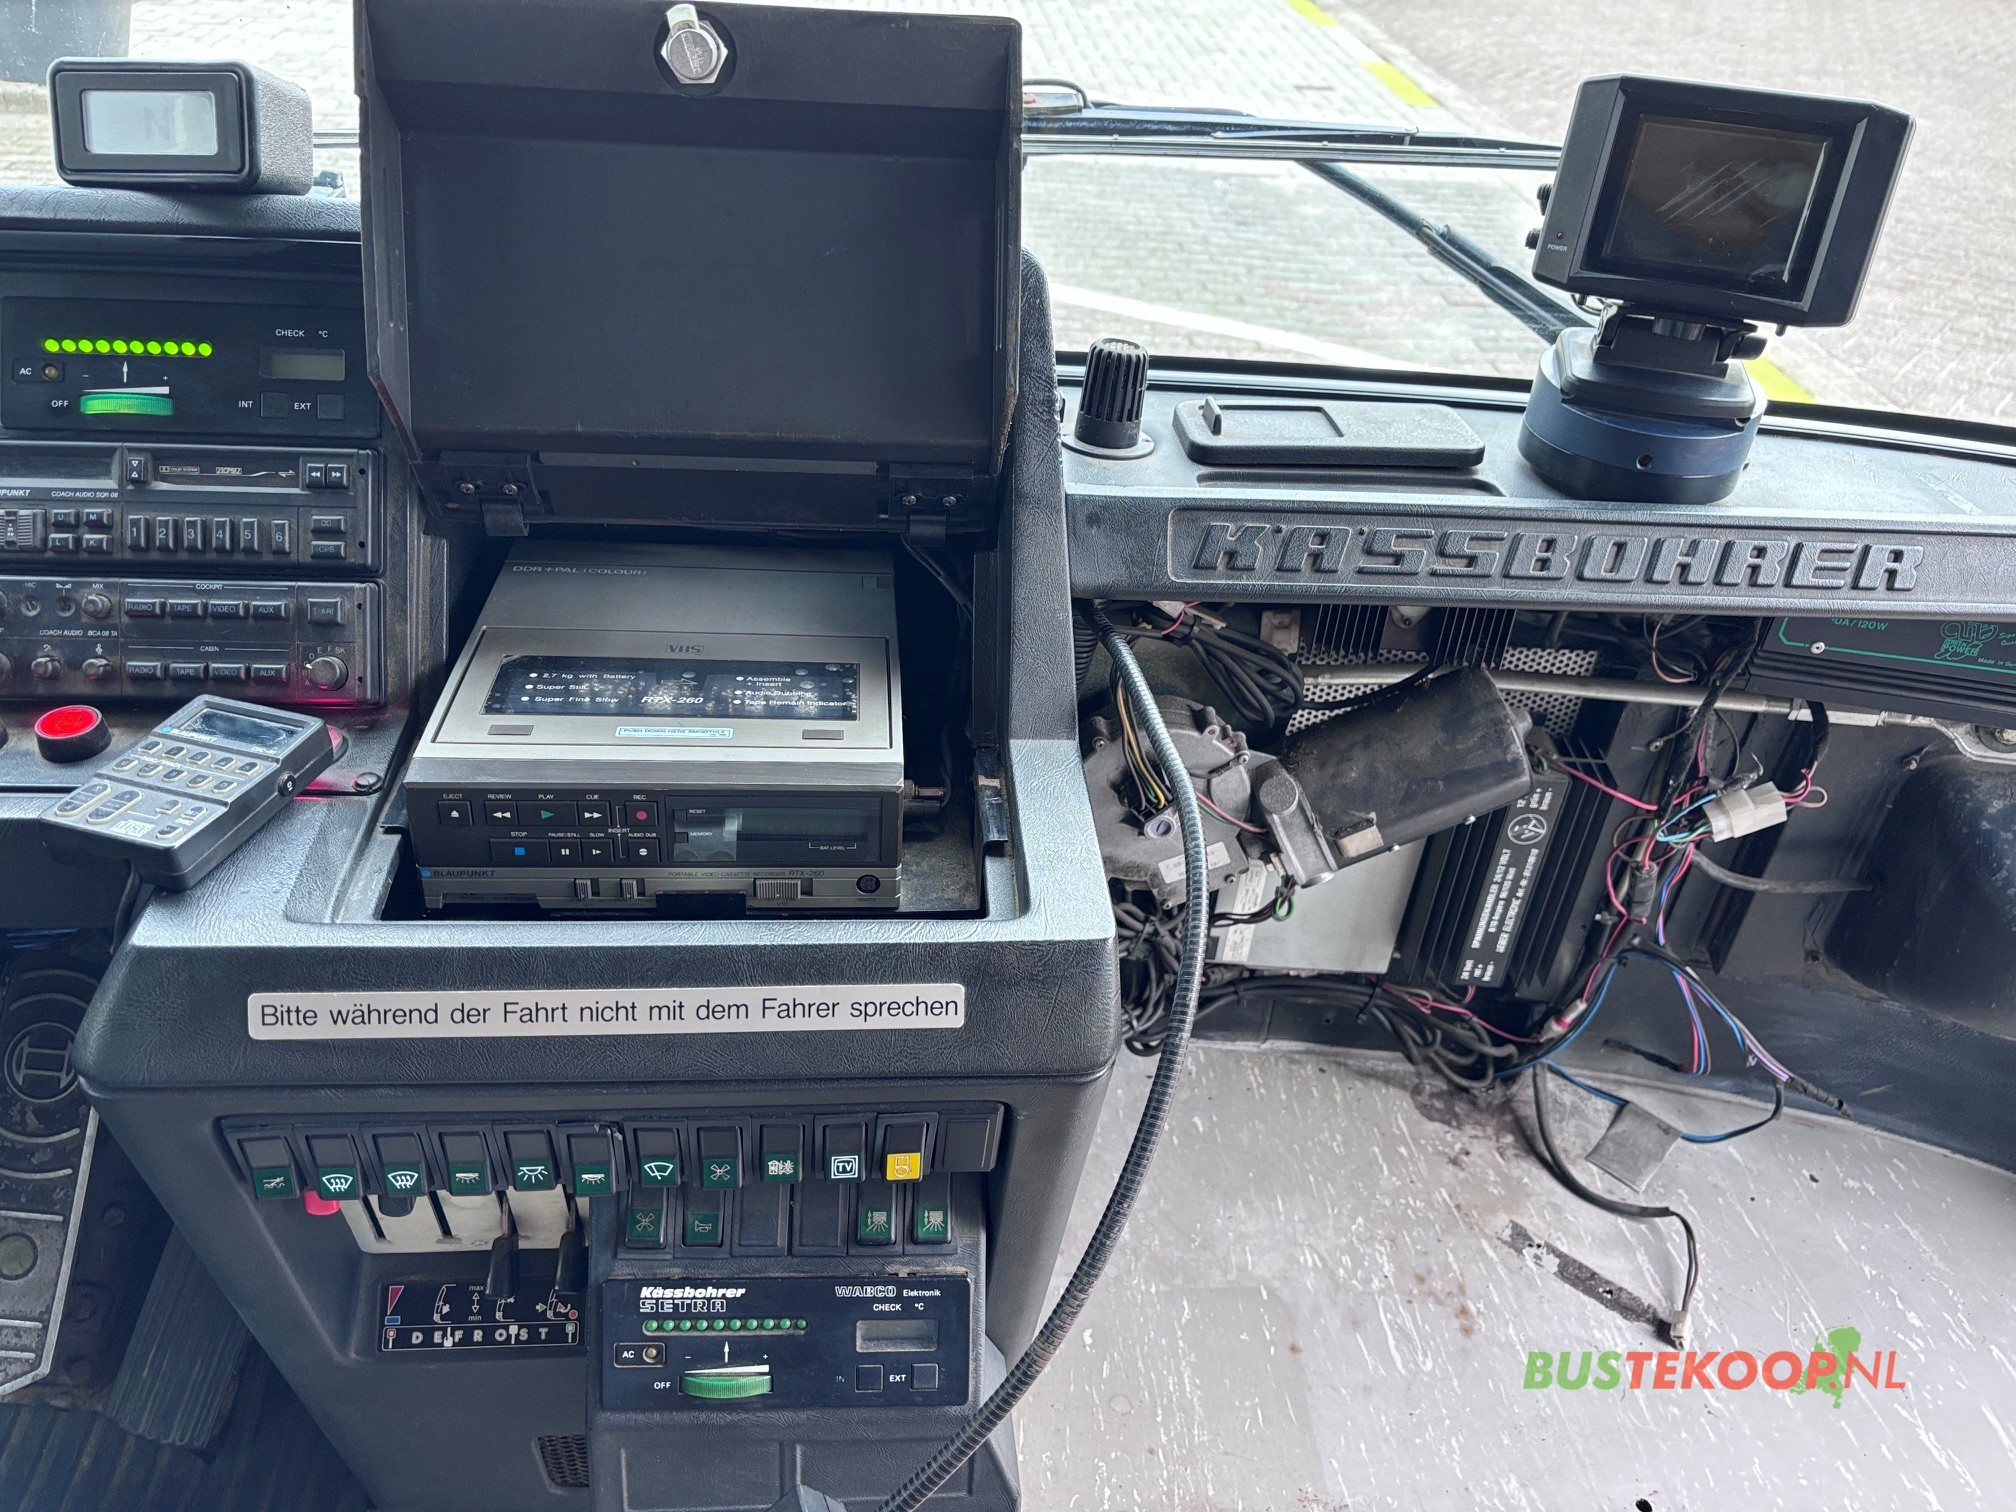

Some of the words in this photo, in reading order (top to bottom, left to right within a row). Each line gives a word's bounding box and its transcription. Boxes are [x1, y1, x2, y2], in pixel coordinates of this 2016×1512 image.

[1547, 243, 1568, 253] POWER
[275, 328, 305, 337] CHECK
[19, 366, 32, 376] AC
[51, 399, 69, 408] OFF
[238, 400, 253, 409] INT
[294, 402, 311, 410] EXT
[132, 527, 138, 536] 1
[159, 528, 167, 539] 2
[187, 529, 195, 539] 3
[216, 530, 224, 539] 4
[244, 530, 252, 540] 5
[275, 532, 283, 542] 6
[173, 604, 191, 612] TAPE
[669, 644, 701, 652] VHS
[640, 696, 704, 704] RTX-260
[433, 869, 495, 877] BLAUPUNKT
[788, 869, 825, 877] RTX-260
[261, 1004, 318, 1027] Bitte
[329, 1003, 439, 1026] während
[450, 1003, 491, 1025] der
[503, 1002, 569, 1024] Fahrt
[579, 999, 637, 1022] nicht
[649, 1000, 685, 1020] mit
[696, 1000, 749, 1020] dem
[762, 998, 840, 1019] Fahrer
[850, 996, 958, 1022] sprechen
[837, 1162, 852, 1172] TV
[640, 1286, 746, 1298] Kässbohrer
[835, 1285, 897, 1297] WABCO
[903, 1289, 941, 1297] Elektronik
[640, 1299, 726, 1313] SETRA
[873, 1304, 902, 1312] CHECK
[622, 1350, 635, 1358] AC
[889, 1374, 907, 1382] EXT
[653, 1381, 672, 1390] OFF
